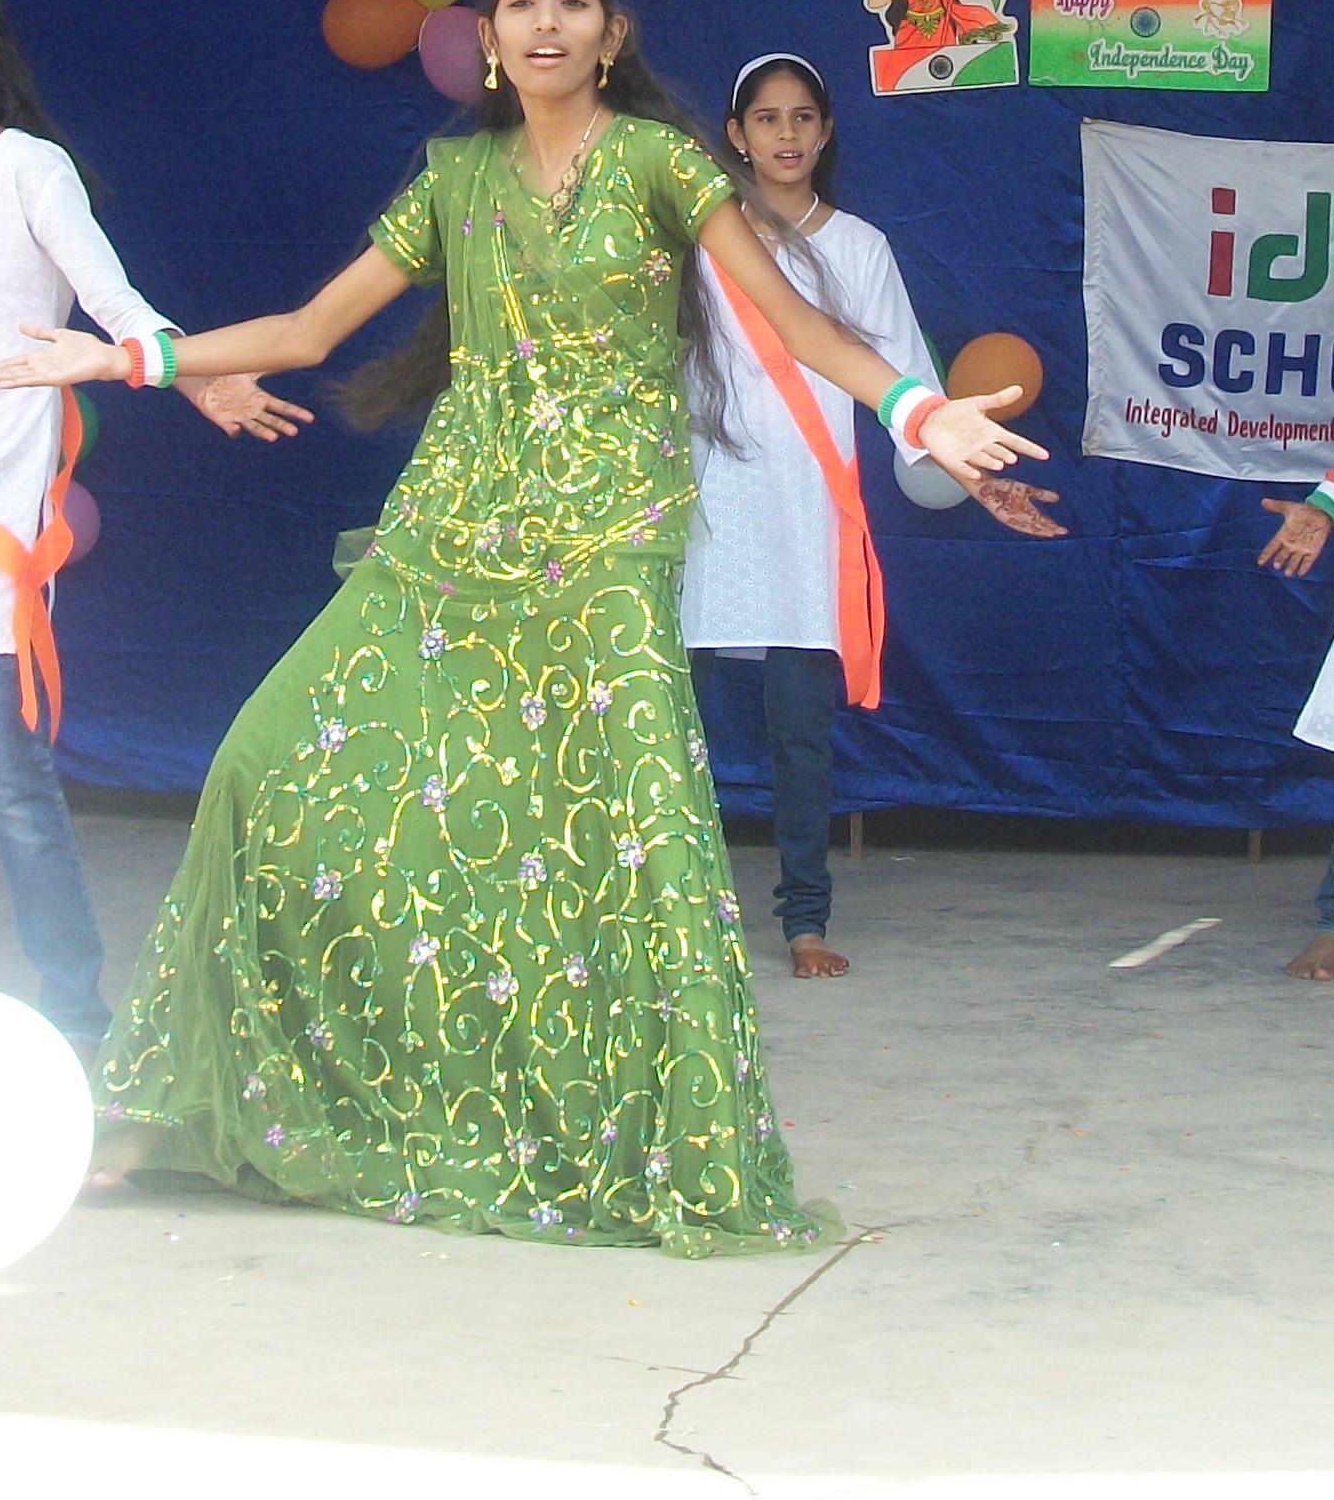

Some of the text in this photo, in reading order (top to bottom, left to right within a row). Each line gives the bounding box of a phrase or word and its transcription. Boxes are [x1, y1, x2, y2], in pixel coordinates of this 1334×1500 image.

[1089, 43, 1251, 77] Independence Day
[1124, 397, 1217, 438] Integrated
